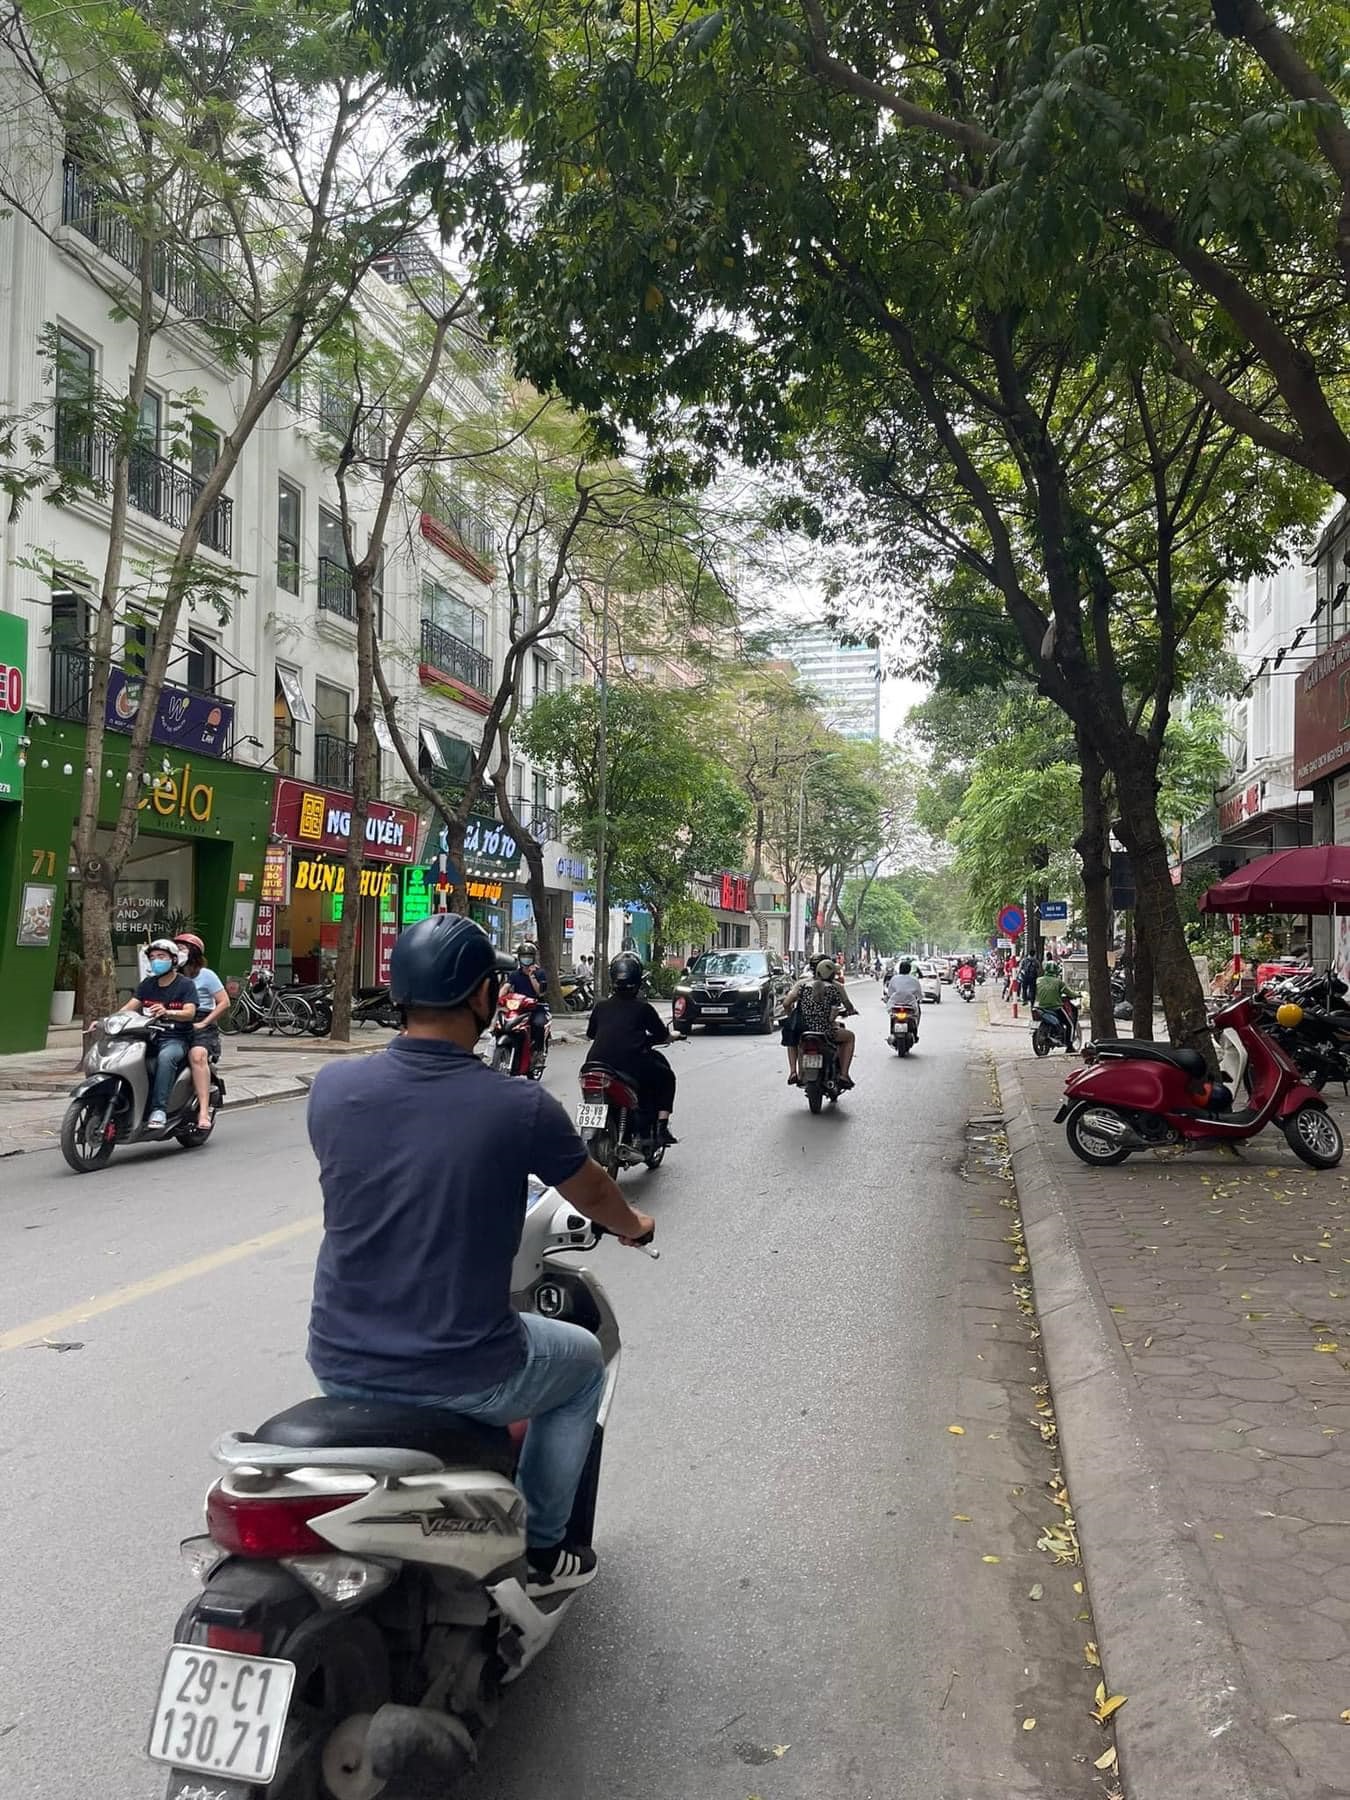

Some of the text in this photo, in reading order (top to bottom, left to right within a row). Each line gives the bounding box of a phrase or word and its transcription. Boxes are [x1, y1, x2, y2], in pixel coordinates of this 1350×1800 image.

[137, 763, 213, 821] ela
[32, 850, 56, 876] 71
[117, 909, 139, 919] AND
[138, 898, 165, 908] DRINK
[115, 922, 128, 932] BE
[176, 1655, 271, 1716] 29-C1
[161, 1708, 270, 1774] 130.71
